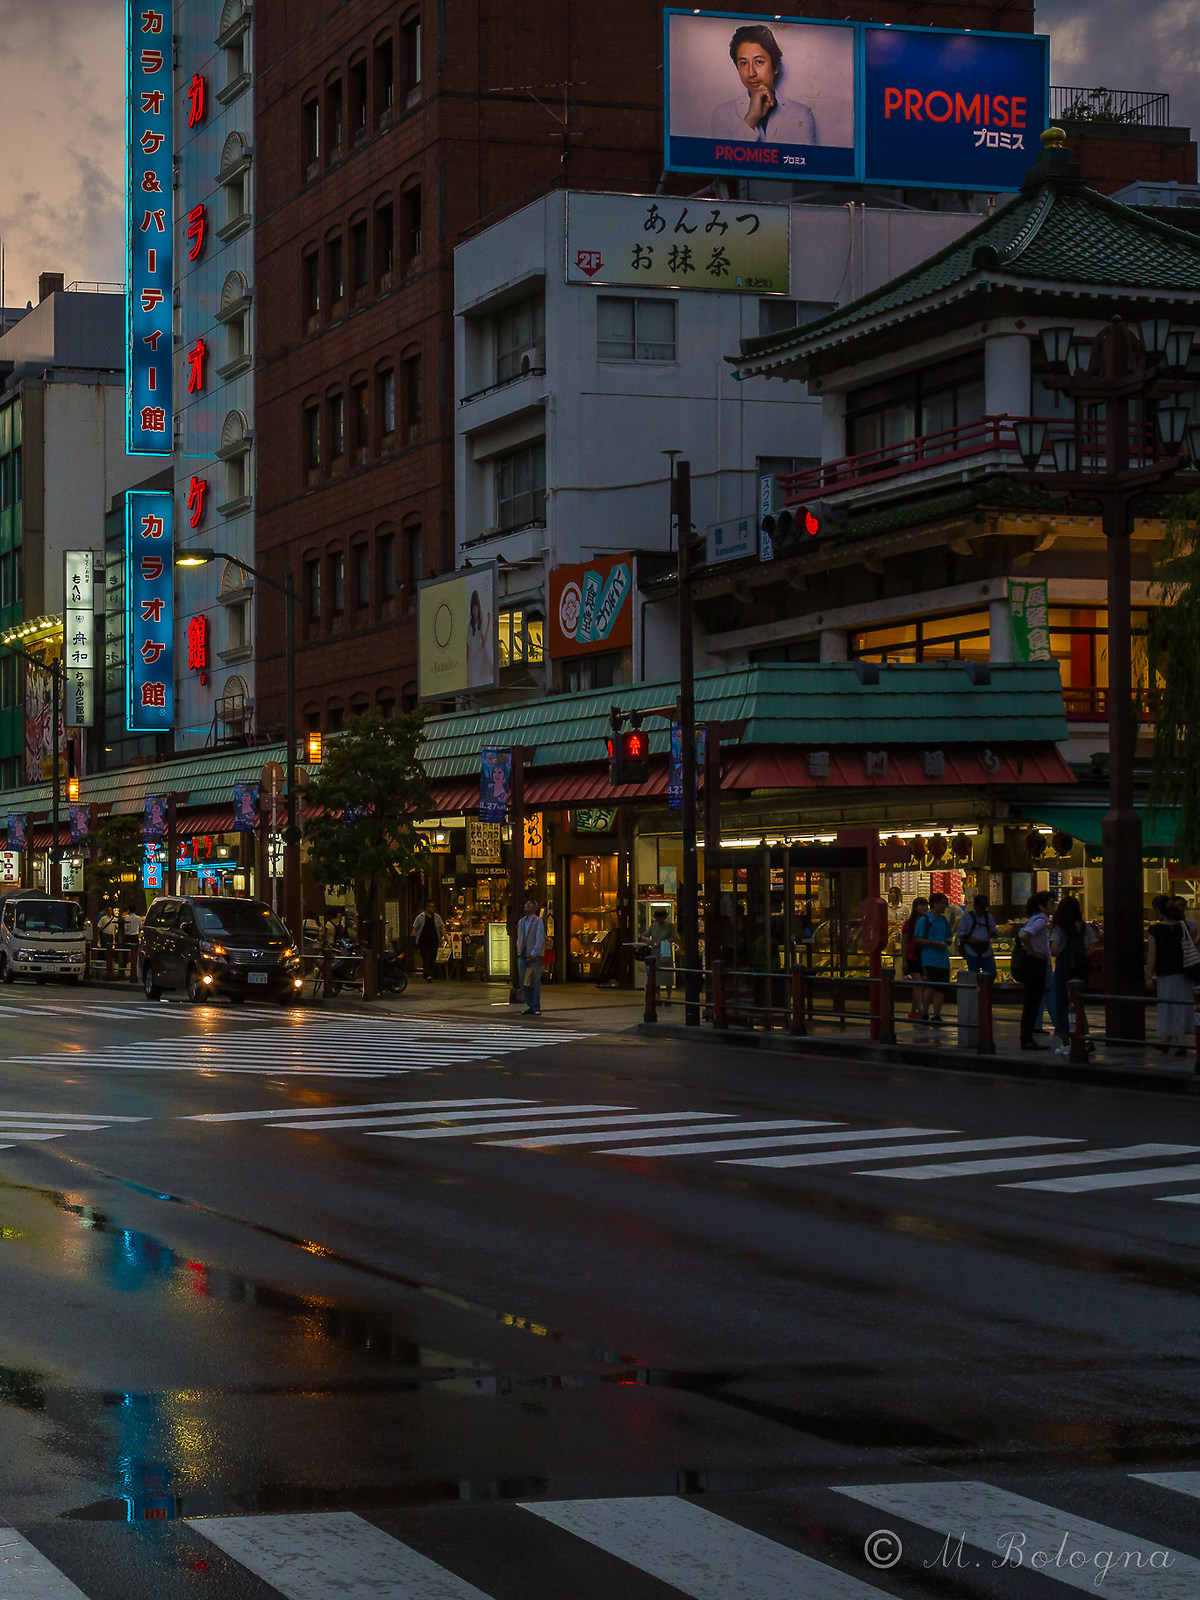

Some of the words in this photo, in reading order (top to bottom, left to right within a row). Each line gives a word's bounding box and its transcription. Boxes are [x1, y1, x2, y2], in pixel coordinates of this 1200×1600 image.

[884, 87, 1027, 128] PROMISE
[715, 145, 779, 164] PROMISE
[783, 155, 806, 165] プロミス
[973, 128, 1025, 150] プロミス
[140, 9, 166, 432] カラオケ&パーティー館
[644, 203, 760, 236] あんみつ
[579, 252, 600, 269] 2F
[631, 243, 731, 277] お抹茶
[762, 480, 771, 557] スクラル式
[140, 513, 166, 707] カラオケ館
[71, 631, 88, 663] 舟和
[75, 671, 85, 725] ちゃんこ部屋
